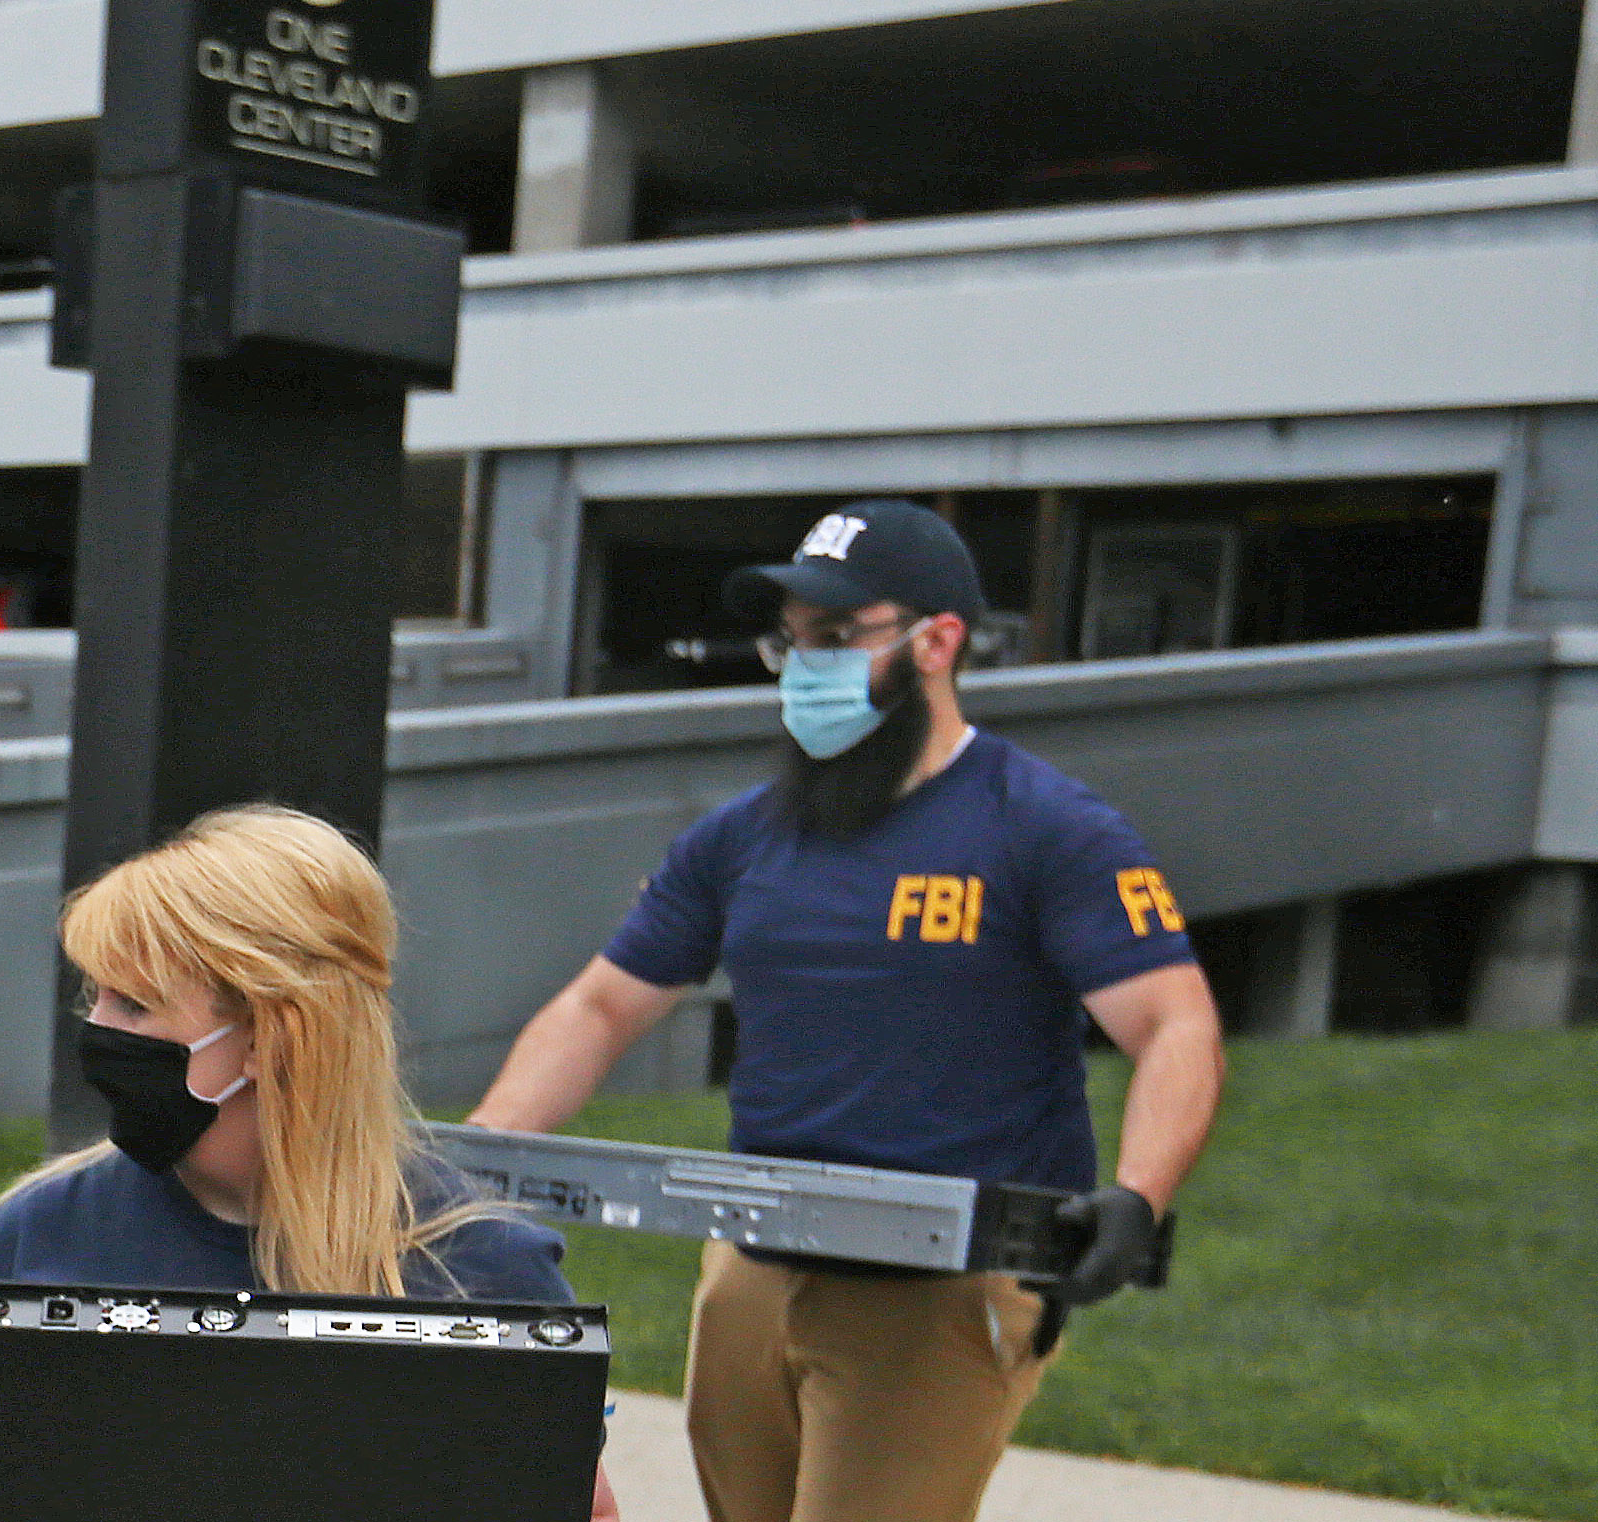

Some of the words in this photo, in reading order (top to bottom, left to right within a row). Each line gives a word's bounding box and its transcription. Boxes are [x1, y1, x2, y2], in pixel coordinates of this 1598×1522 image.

[265, 9, 350, 65] ONE
[197, 38, 420, 124] CLEVELAND
[227, 93, 381, 162] CENTER
[886, 873, 985, 945] FBI
